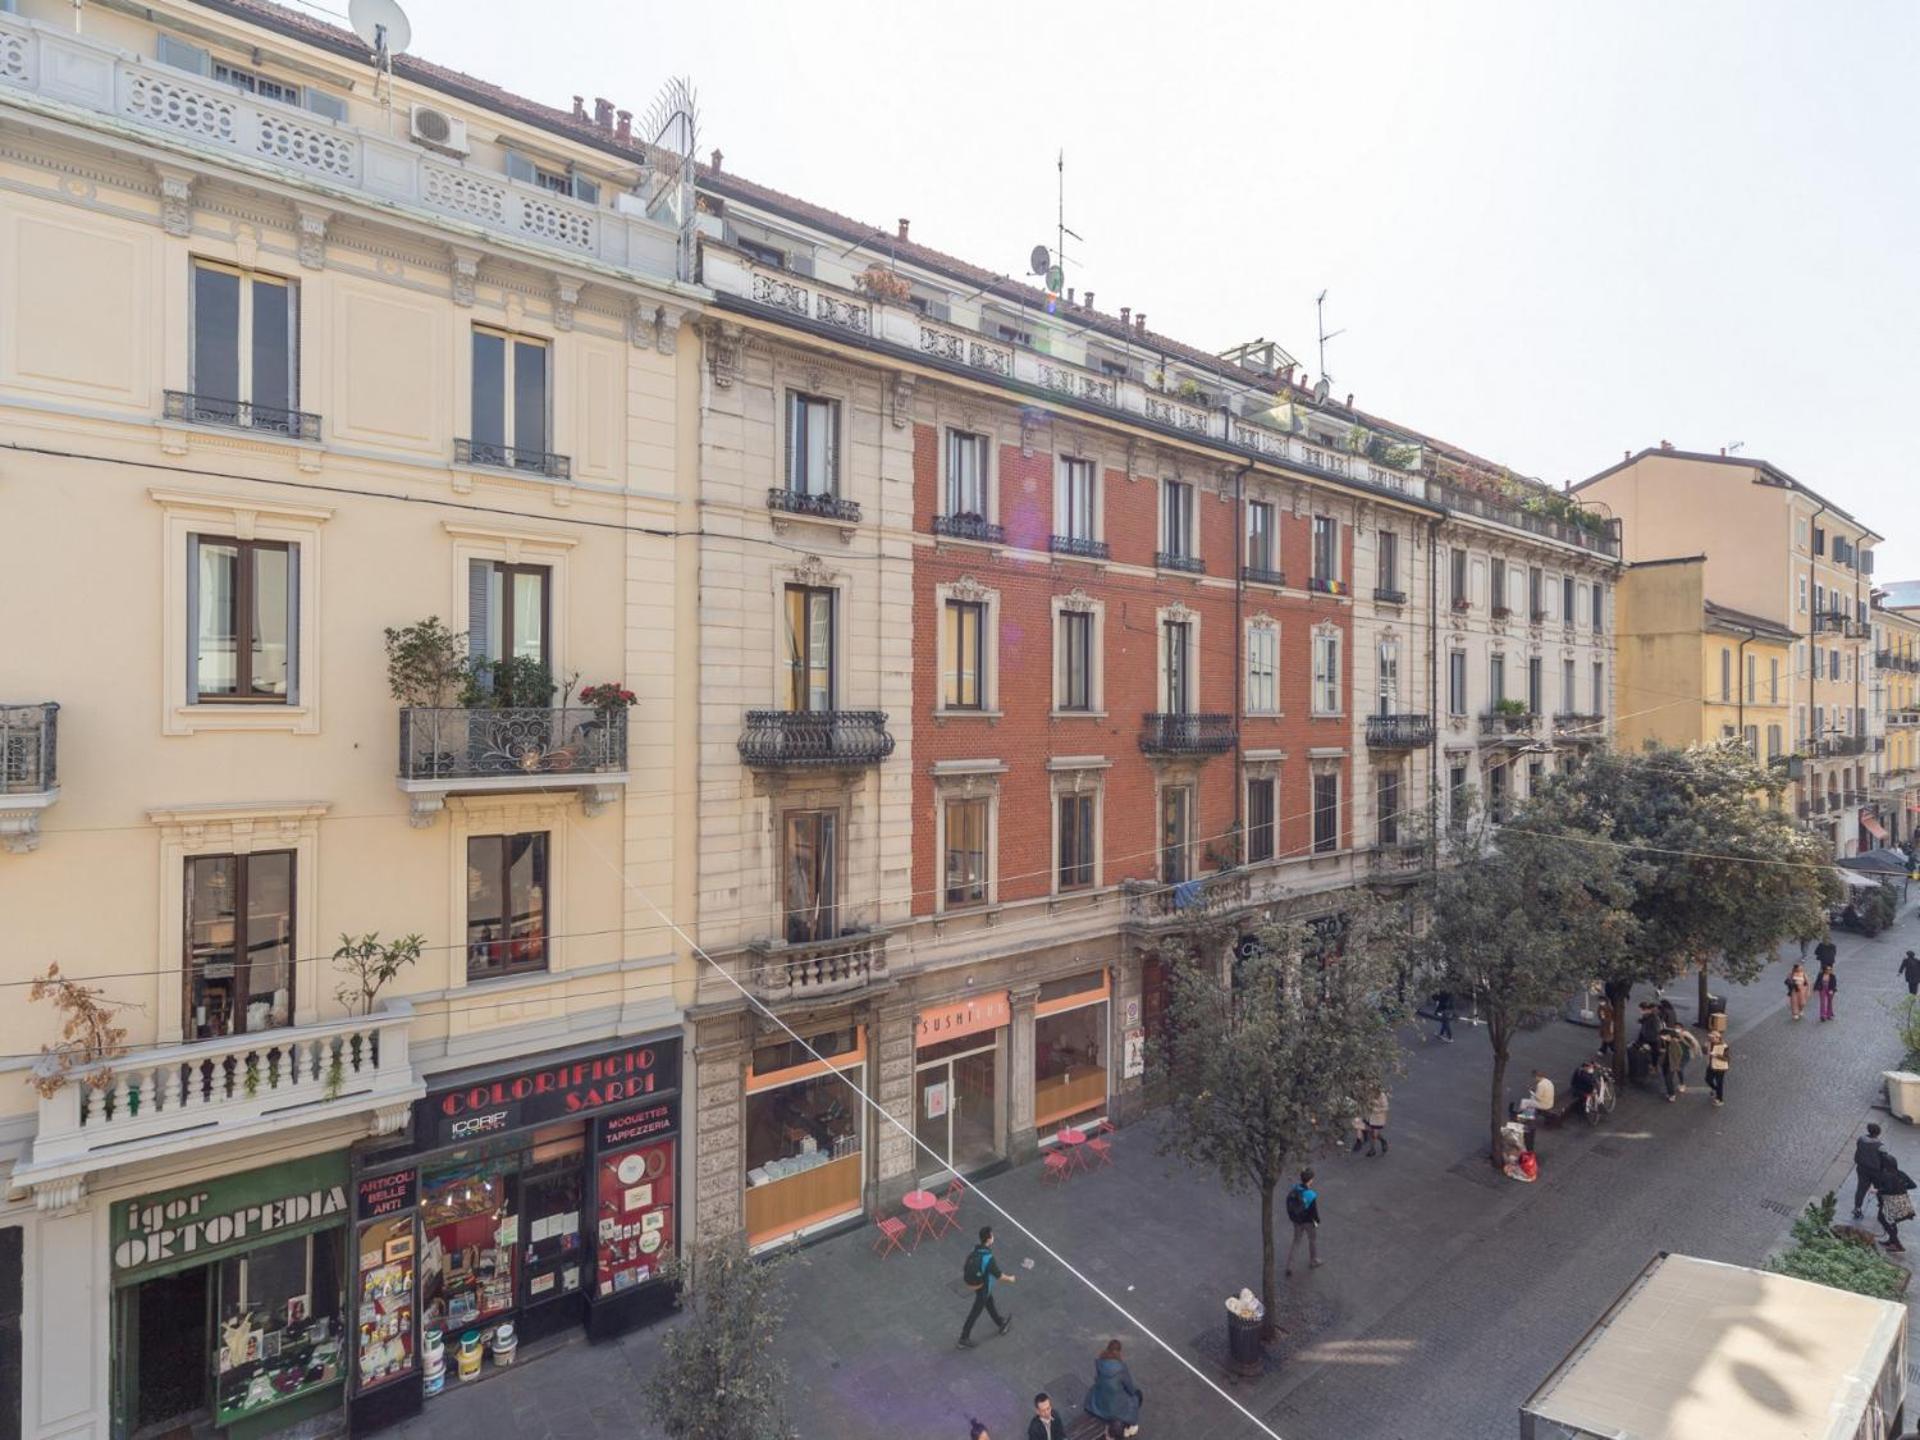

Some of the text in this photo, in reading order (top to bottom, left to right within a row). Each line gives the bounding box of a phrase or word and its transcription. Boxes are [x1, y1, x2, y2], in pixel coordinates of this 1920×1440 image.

[923, 1011, 971, 1034] SUSHI
[442, 1048, 655, 1116] COLORIFICIO
[566, 1073, 655, 1113] SARPI
[609, 1106, 669, 1129] MOQUETTES
[606, 1119, 671, 1143] TAPPEZZERIA
[360, 1170, 415, 1194] ARTICOLI
[368, 1185, 406, 1203] BELLE
[129, 1193, 208, 1234] igor
[374, 1199, 401, 1215] ARTI
[115, 1186, 348, 1268] ORTOPEDIA
